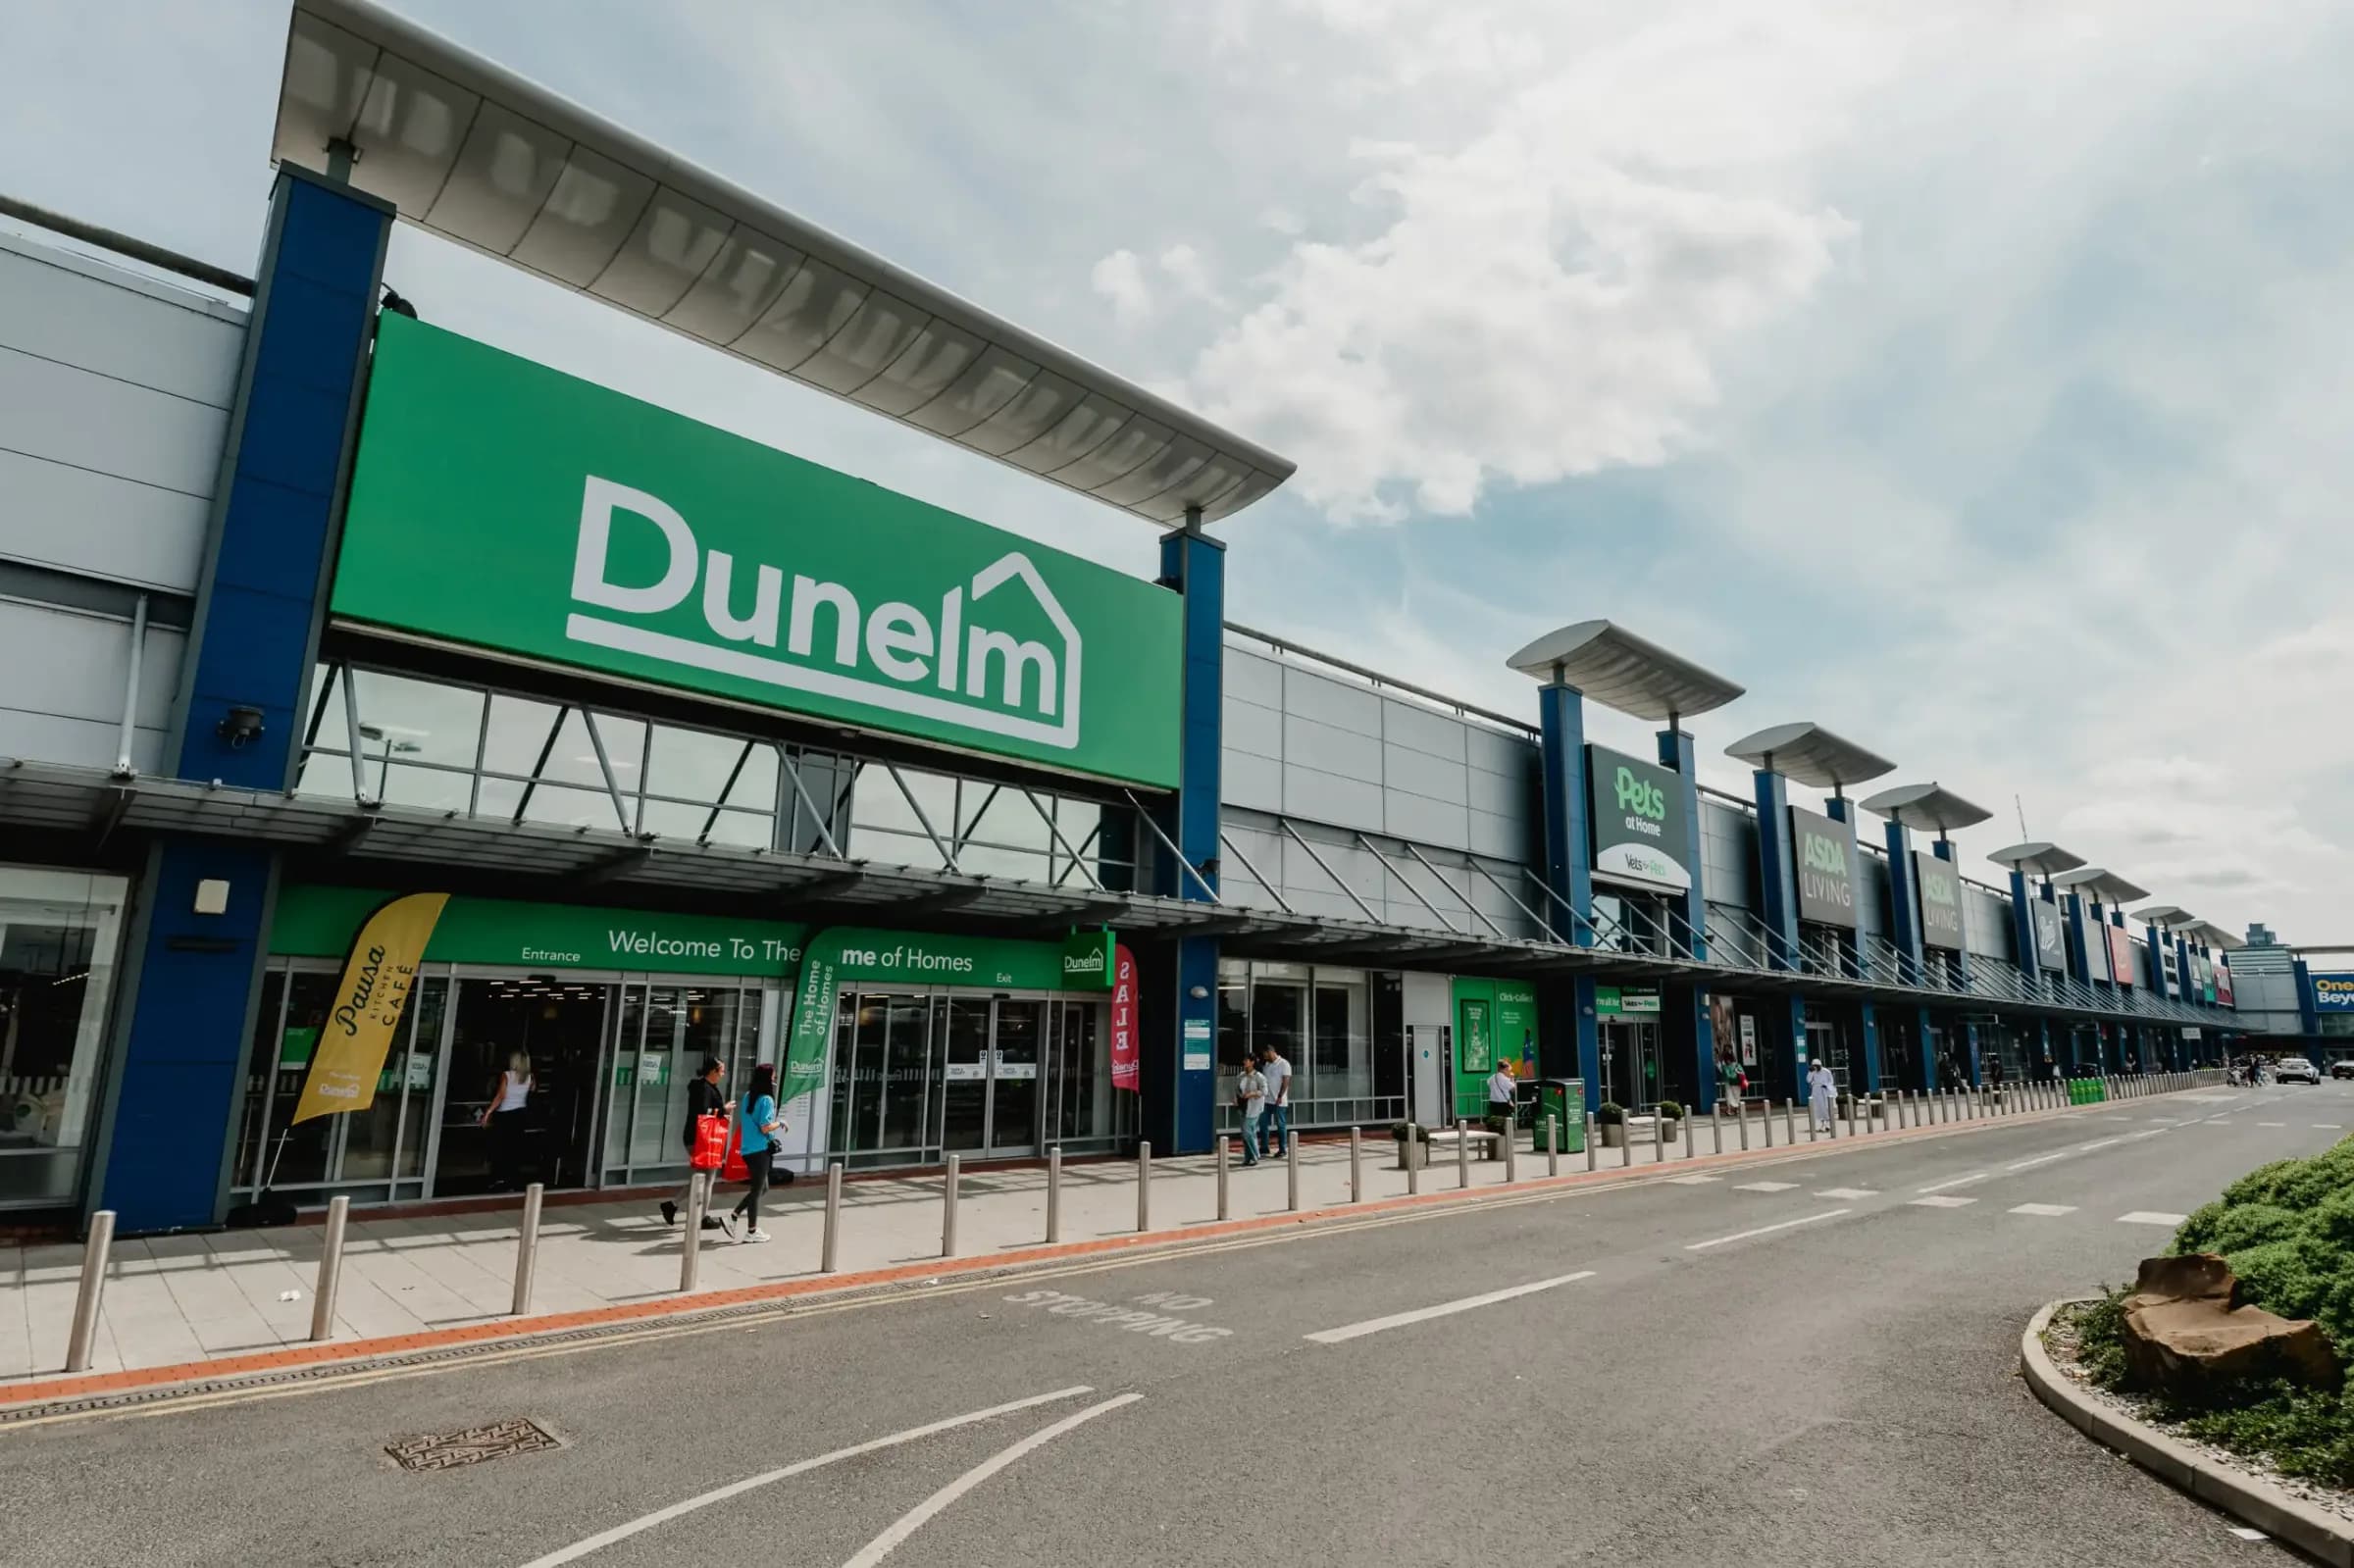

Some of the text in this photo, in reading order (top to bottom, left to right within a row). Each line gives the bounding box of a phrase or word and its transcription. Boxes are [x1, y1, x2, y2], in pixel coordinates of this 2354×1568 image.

[569, 475, 1082, 749] Dunelm
[1614, 767, 1665, 821] Pets
[1625, 816, 1661, 836] at Home
[1624, 853, 1643, 872] Vets
[1803, 832, 1847, 878] ASDA
[1804, 872, 1851, 907] LIVING
[1925, 907, 1958, 932] LIVING
[522, 947, 581, 963] Entrance
[608, 930, 973, 973] Welcome To The me of Homes
[1064, 947, 1103, 972] Dunelm
[334, 944, 385, 1037] Pausa
[370, 965, 394, 1020] KITCHEN
[382, 964, 413, 1027] CAFÉ
[798, 959, 821, 1037] The Home
[997, 972, 1012, 983] Exit
[2316, 980, 2354, 990] One
[815, 965, 834, 1036] of Homes
